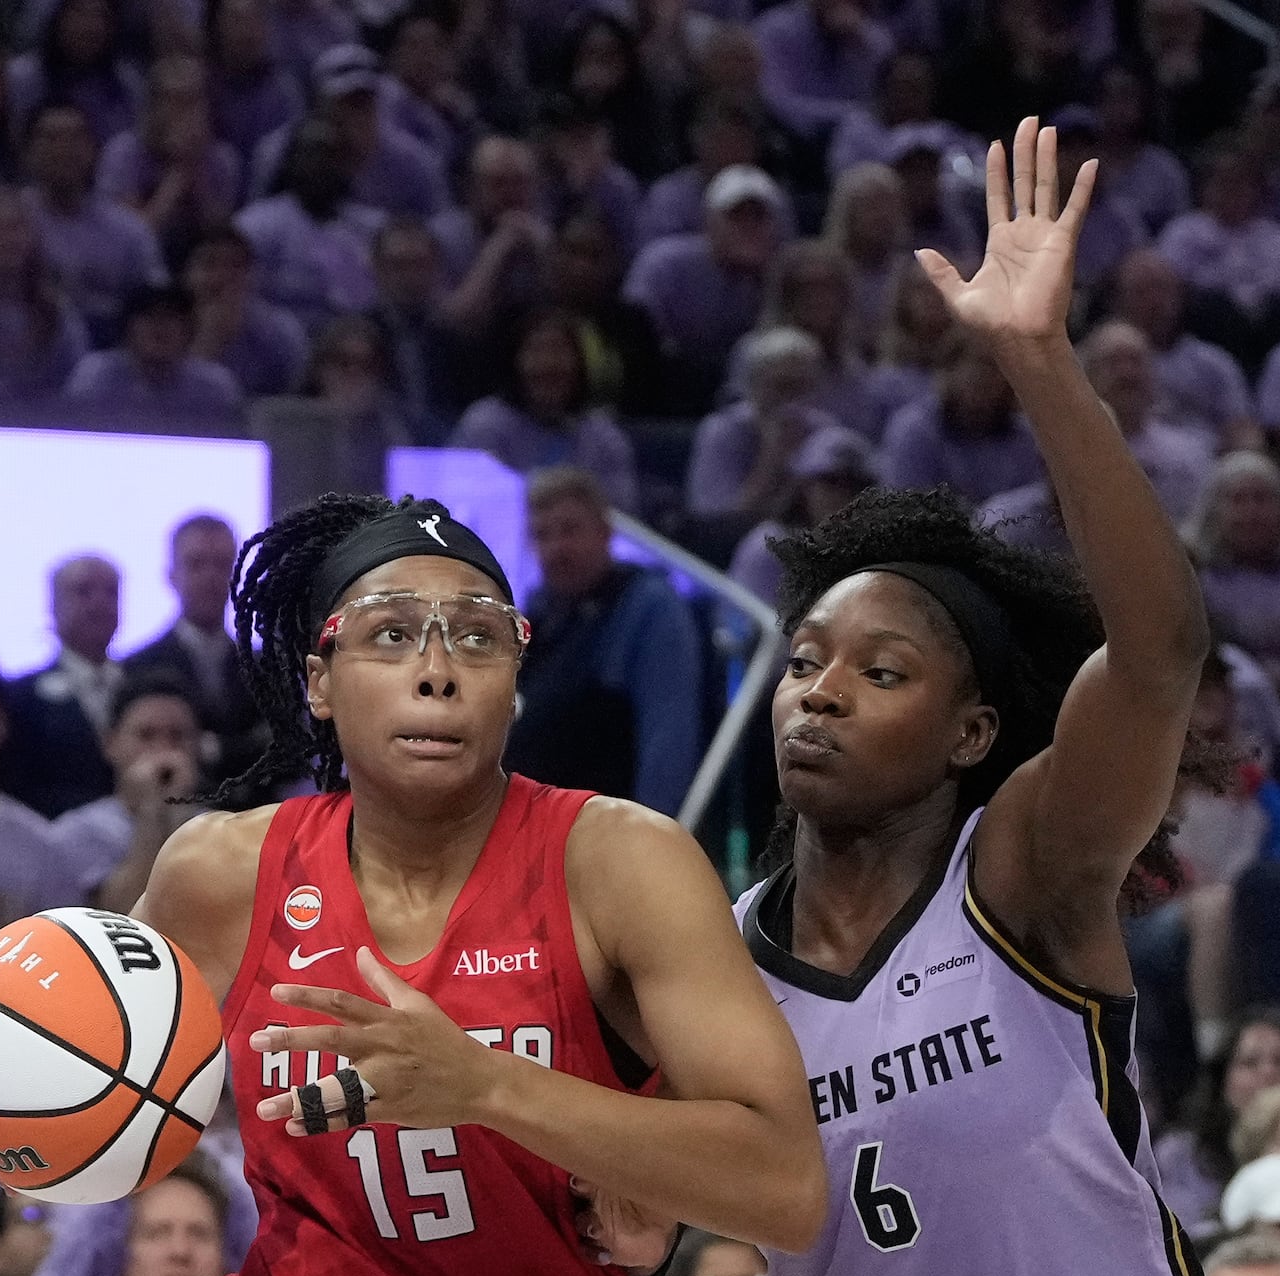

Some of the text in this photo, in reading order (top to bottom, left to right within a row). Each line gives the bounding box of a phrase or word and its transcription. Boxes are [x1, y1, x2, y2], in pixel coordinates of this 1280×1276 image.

[452, 946, 540, 976] Albert
[871, 1014, 1002, 1105] STATE
[346, 1127, 476, 1243] 15
[850, 1140, 922, 1253] 6
